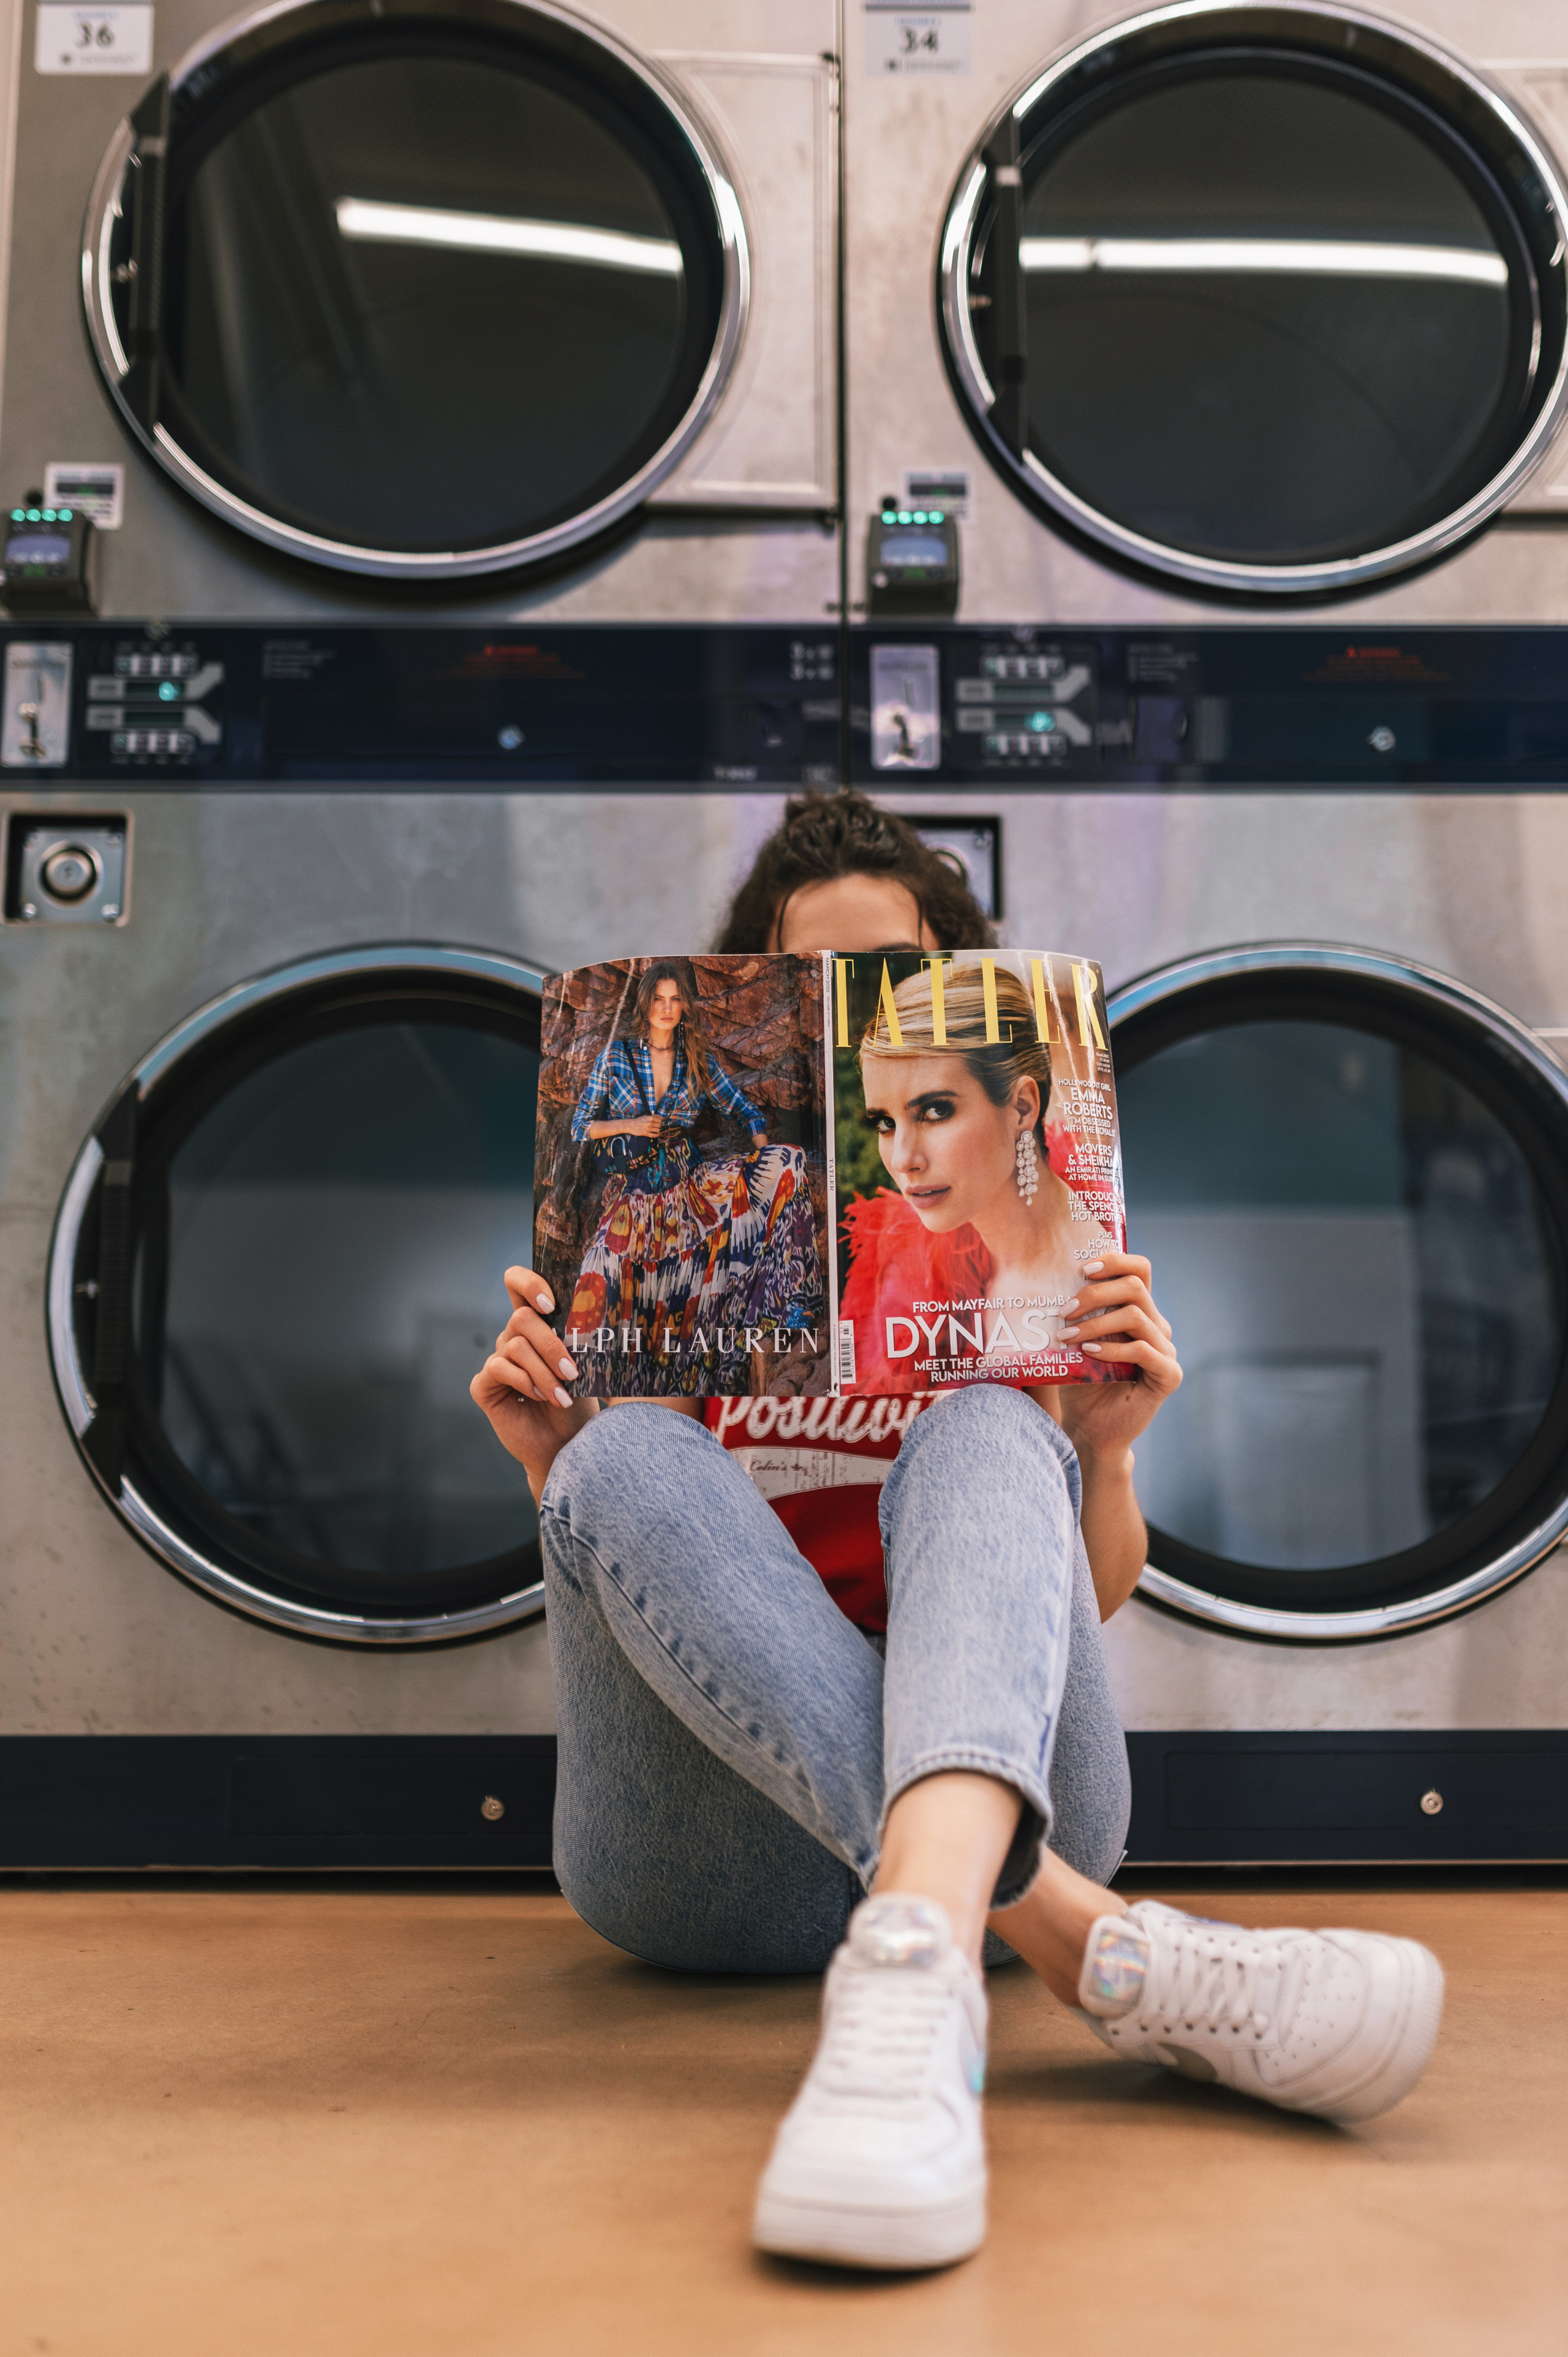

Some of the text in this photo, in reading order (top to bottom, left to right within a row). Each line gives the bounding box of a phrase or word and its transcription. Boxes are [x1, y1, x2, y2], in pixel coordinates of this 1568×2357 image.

[77, 22, 114, 48] 36
[899, 28, 940, 53] 34
[831, 957, 1108, 1051] TATLER
[1058, 1078, 1096, 1088] HOLLYWOOD
[1101, 1083, 1112, 1092] GIRL
[1070, 1087, 1106, 1104] EMMA
[1063, 1101, 1113, 1120] ROBERTS
[1063, 1124, 1082, 1133] WITH
[1082, 1117, 1111, 1128] OBSESSED
[1075, 1143, 1112, 1157] MOVERS
[1068, 1154, 1077, 1165] &
[1068, 1201, 1088, 1211] THE
[1071, 1211, 1092, 1222] HOT
[1088, 1238, 1110, 1249] HOW
[913, 1301, 949, 1313] FROM
[952, 1297, 1005, 1311] MAYFAIR
[1007, 1296, 1025, 1308] TO
[662, 1327, 819, 1353] LAUREN
[914, 1352, 1084, 1371] MEET THE GLOBAL FAMILIES
[930, 1365, 1068, 1382] RUNNING OUR WORLD
